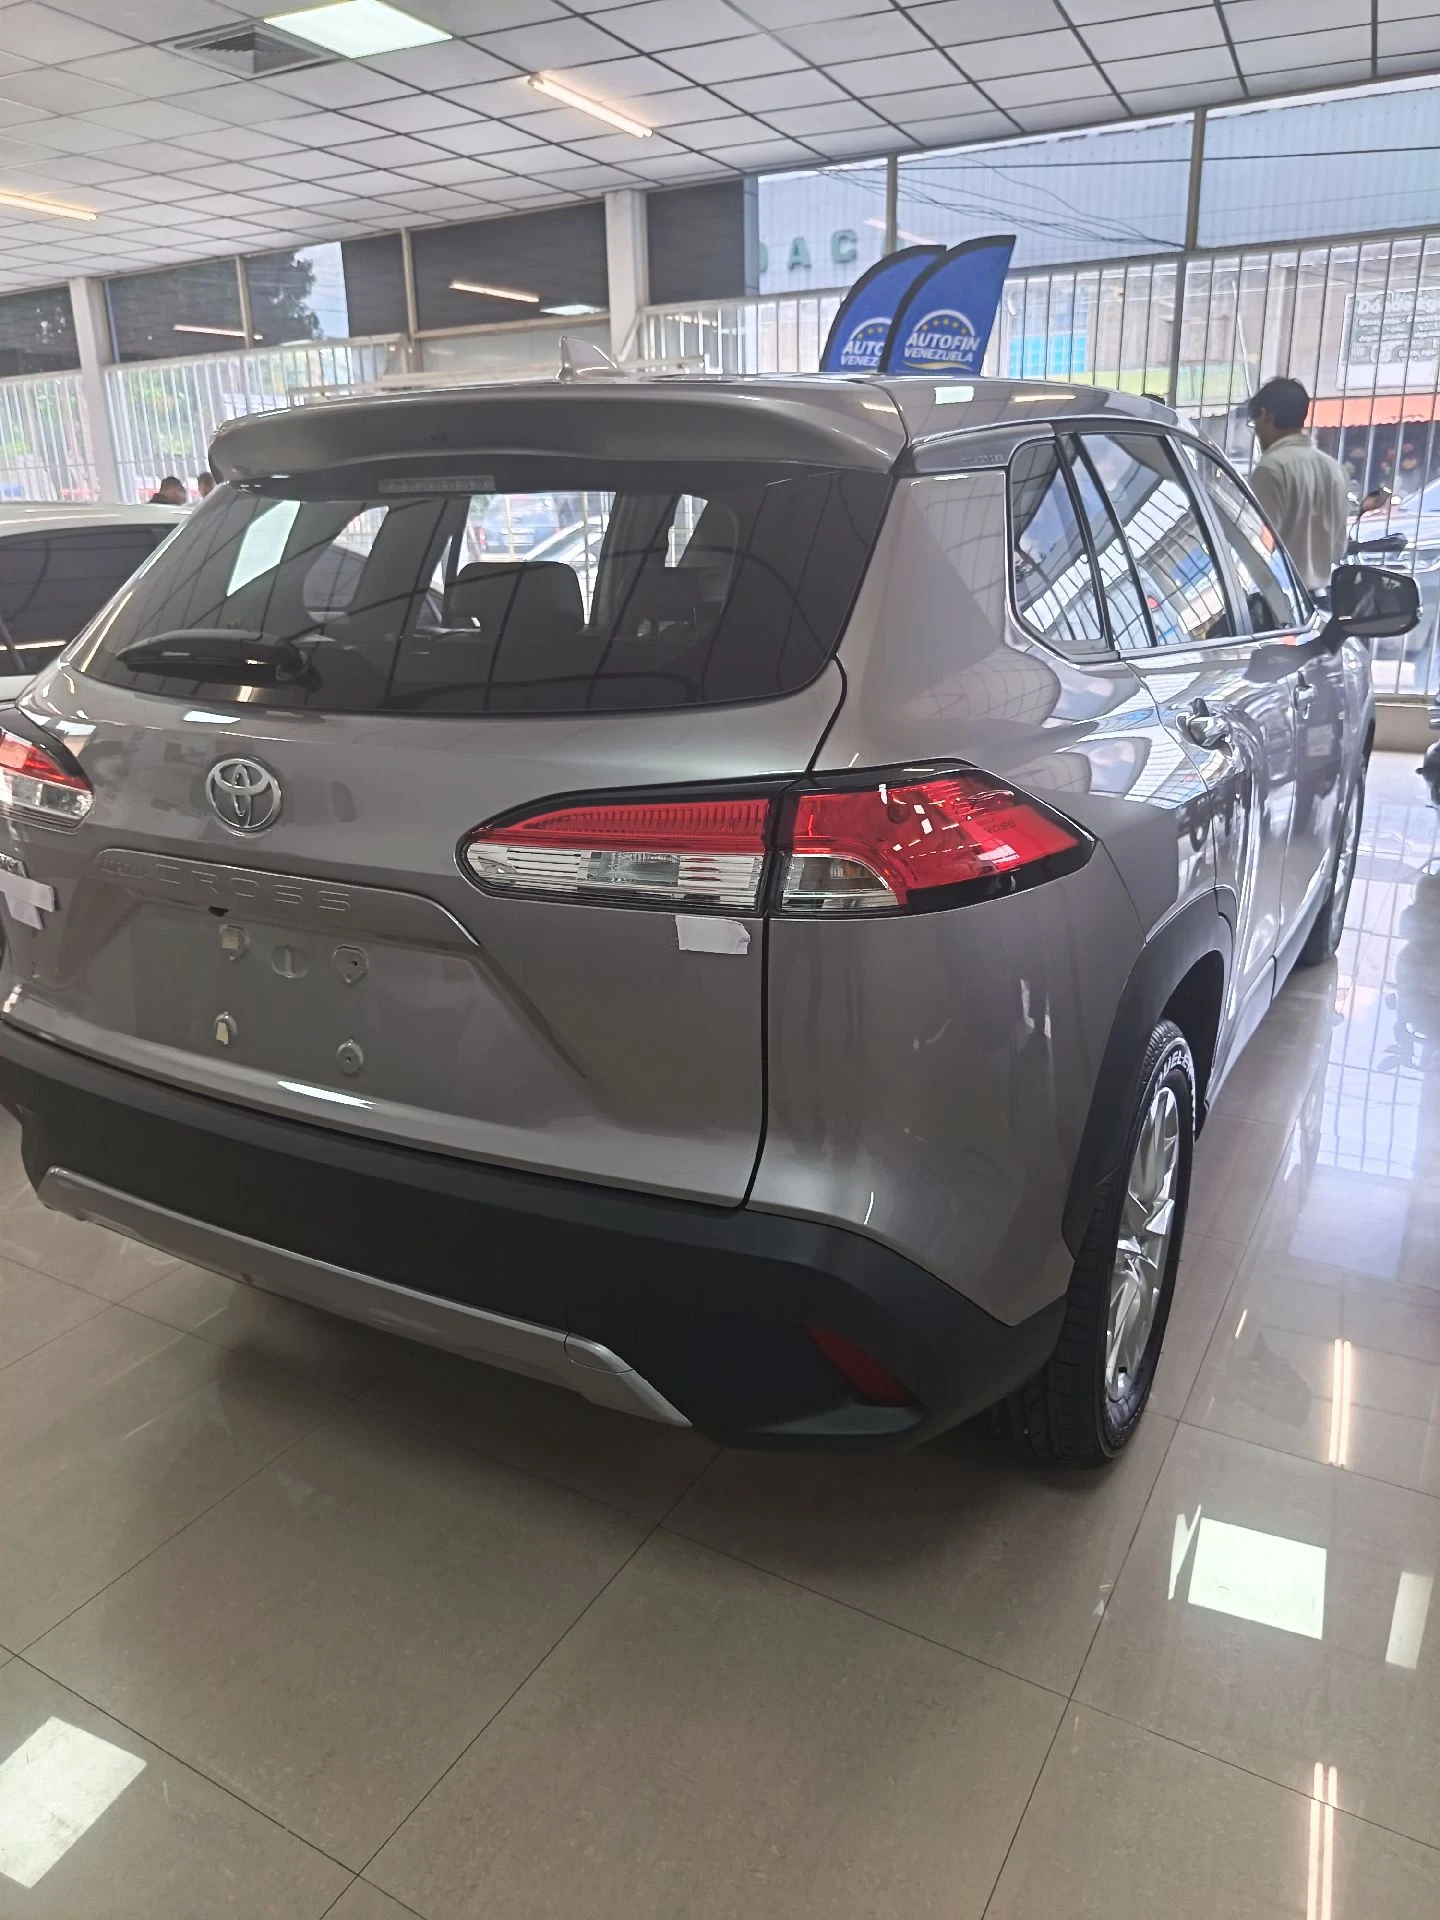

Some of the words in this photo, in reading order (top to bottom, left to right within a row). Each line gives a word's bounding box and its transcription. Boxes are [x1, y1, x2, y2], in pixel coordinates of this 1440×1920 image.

[905, 332, 980, 351] AUTOFIN
[904, 347, 973, 362] VENEZUELA
[155, 863, 351, 912] CROSS
